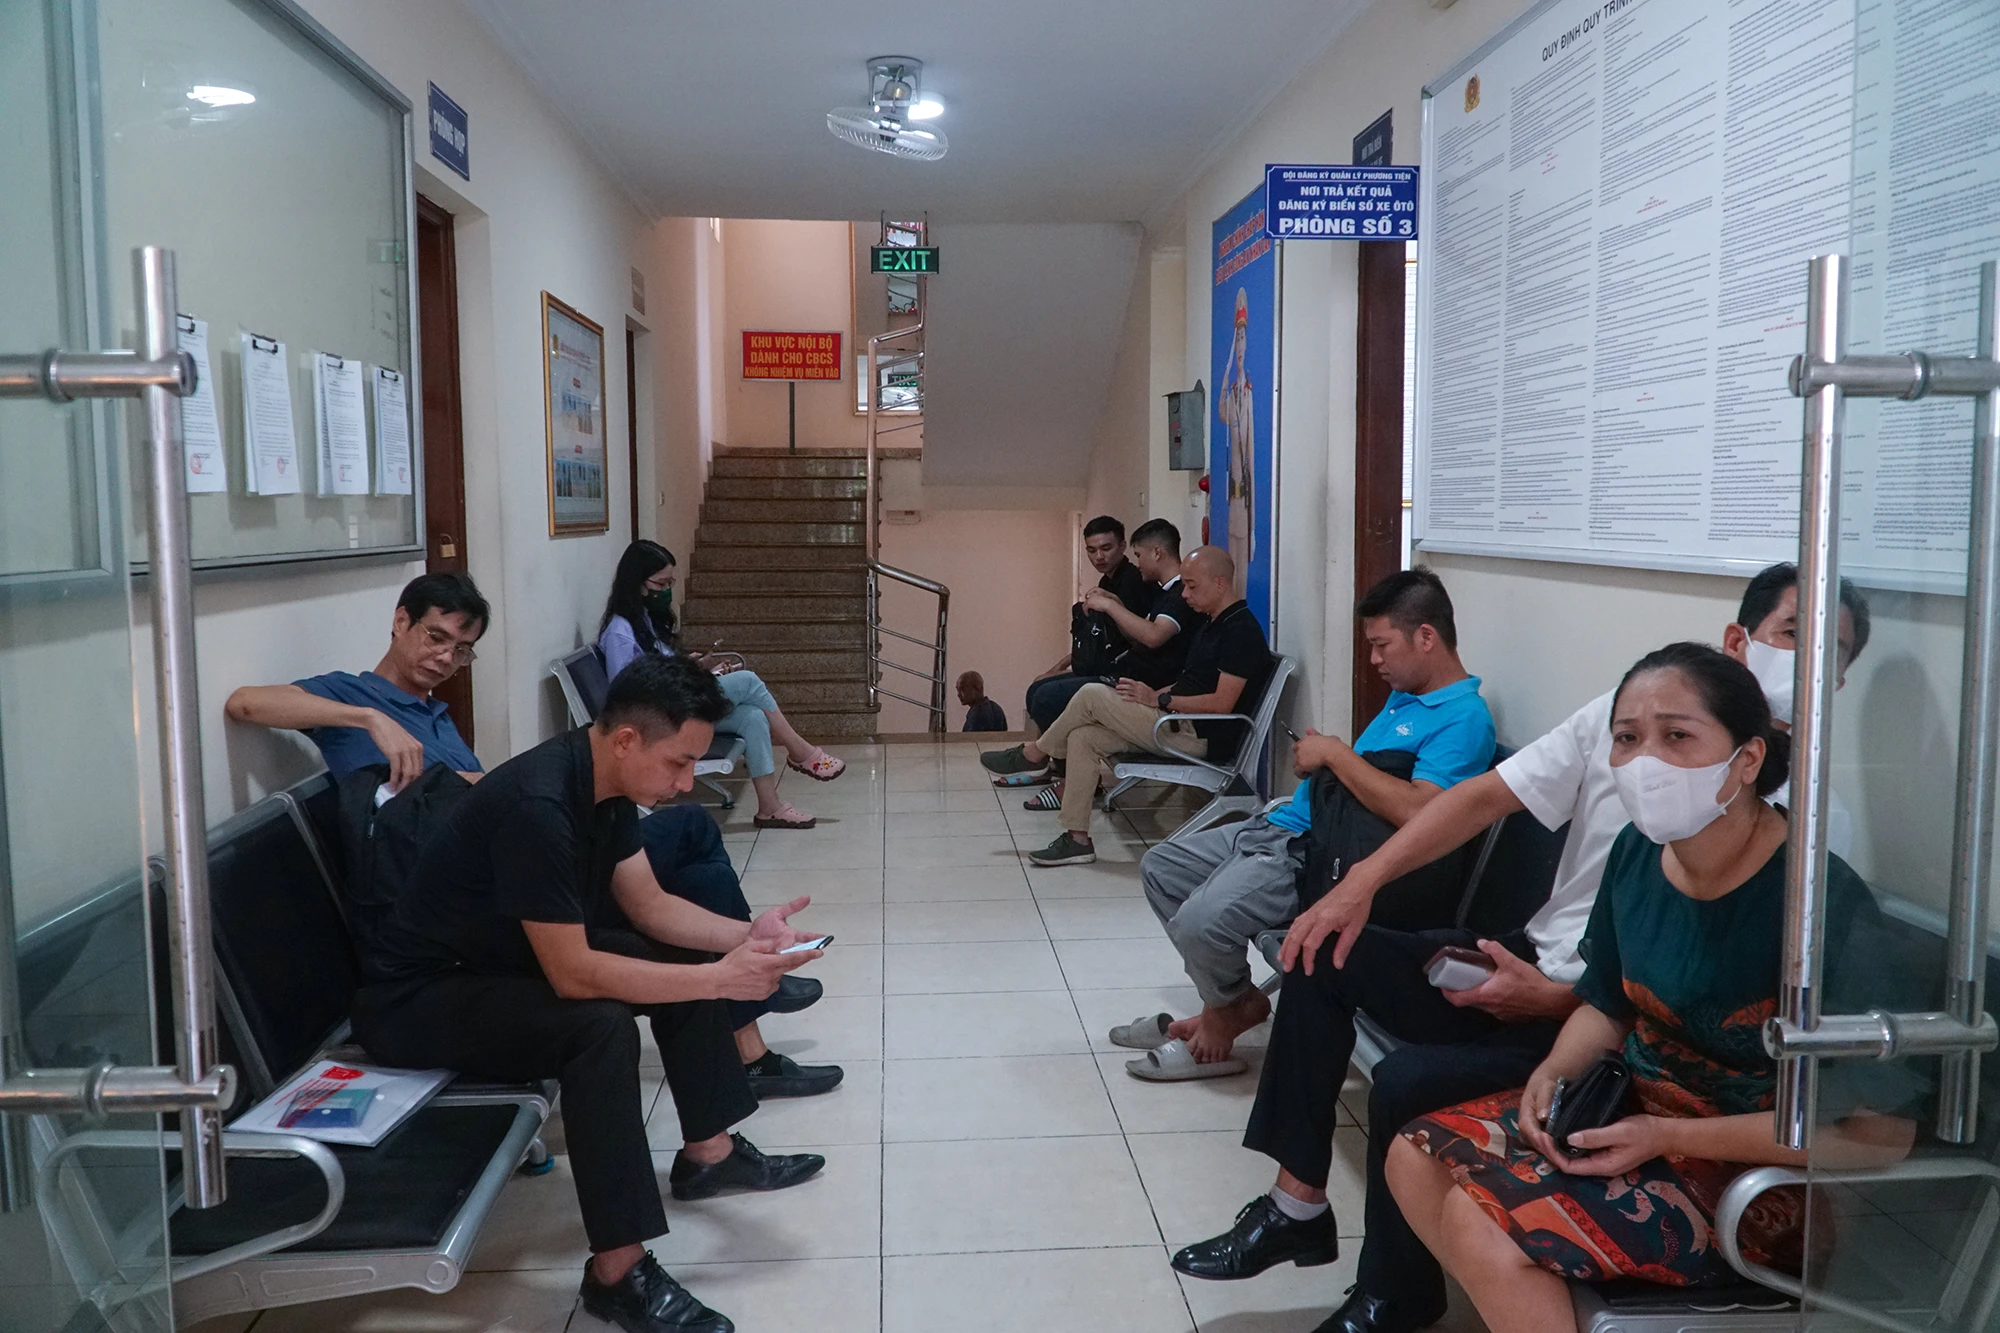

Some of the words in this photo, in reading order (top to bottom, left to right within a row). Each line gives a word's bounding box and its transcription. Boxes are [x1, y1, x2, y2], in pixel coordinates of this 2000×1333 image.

[1542, 39, 1559, 61] QUY
[1560, 24, 1581, 48] ĐỊNH
[1583, 9, 1601, 34] QUY
[1283, 170, 1296, 180] ĐỘI
[1330, 171, 1351, 180] QUẢN
[1363, 172, 1392, 180] PHƯƠNG
[1394, 172, 1411, 181] TIỆN
[1300, 186, 1320, 196] NƠI
[1323, 184, 1344, 196] TRẢ
[1346, 184, 1367, 196] KẾT
[1370, 184, 1392, 198] QUẢ
[1278, 199, 1310, 210] ĐĂNG
[1312, 200, 1327, 210] KÝ
[1330, 198, 1355, 210] BIỂN
[1358, 198, 1374, 212] SỐ
[1376, 202, 1390, 211] XE
[1394, 200, 1414, 212] ÔTÔ
[1279, 215, 1356, 234] PHÒNG
[1362, 214, 1392, 234] SỐ
[1399, 219, 1412, 234] 3
[879, 251, 930, 270] EXIT
[751, 336, 772, 348] KHU
[774, 336, 795, 350] VỰC
[798, 334, 816, 350] NỘI
[818, 335, 832, 351] BỘ
[750, 350, 779, 364] DÀNH
[782, 352, 802, 364] CHO
[806, 352, 833, 364] CBCS
[745, 365, 768, 377] KHÔNG
[770, 366, 792, 379] NHIỆM
[794, 367, 804, 379] VỤ
[824, 366, 838, 378] VÀO
